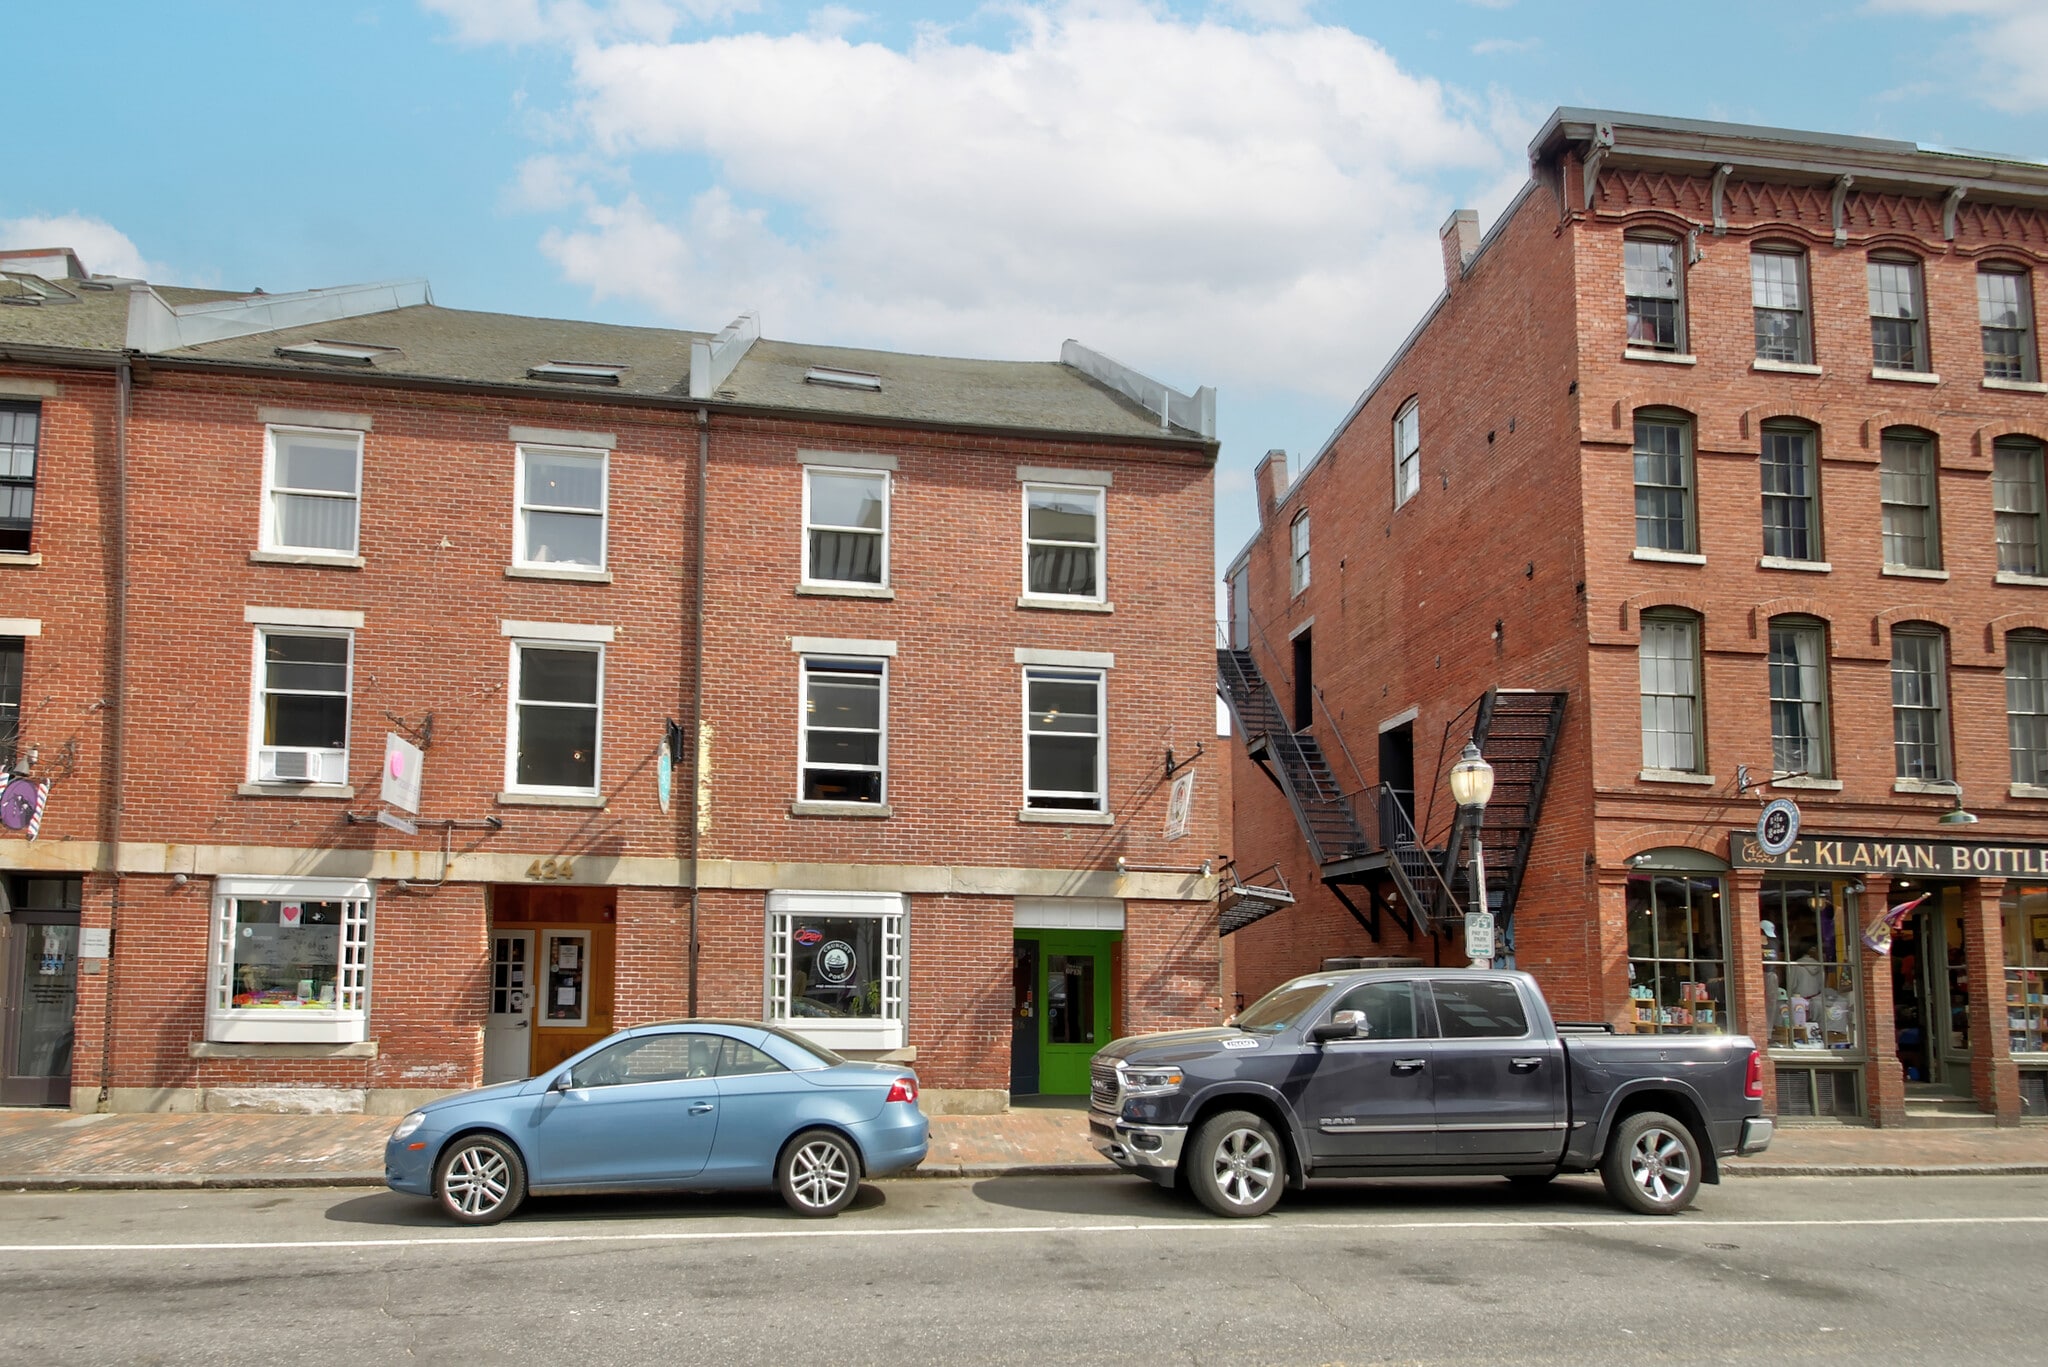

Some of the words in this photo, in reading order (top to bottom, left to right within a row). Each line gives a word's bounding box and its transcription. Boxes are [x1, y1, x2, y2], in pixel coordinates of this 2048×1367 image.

[525, 859, 574, 881] 424
[823, 943, 852, 954] CRUNCHY
[1319, 1117, 1356, 1125] RAM
